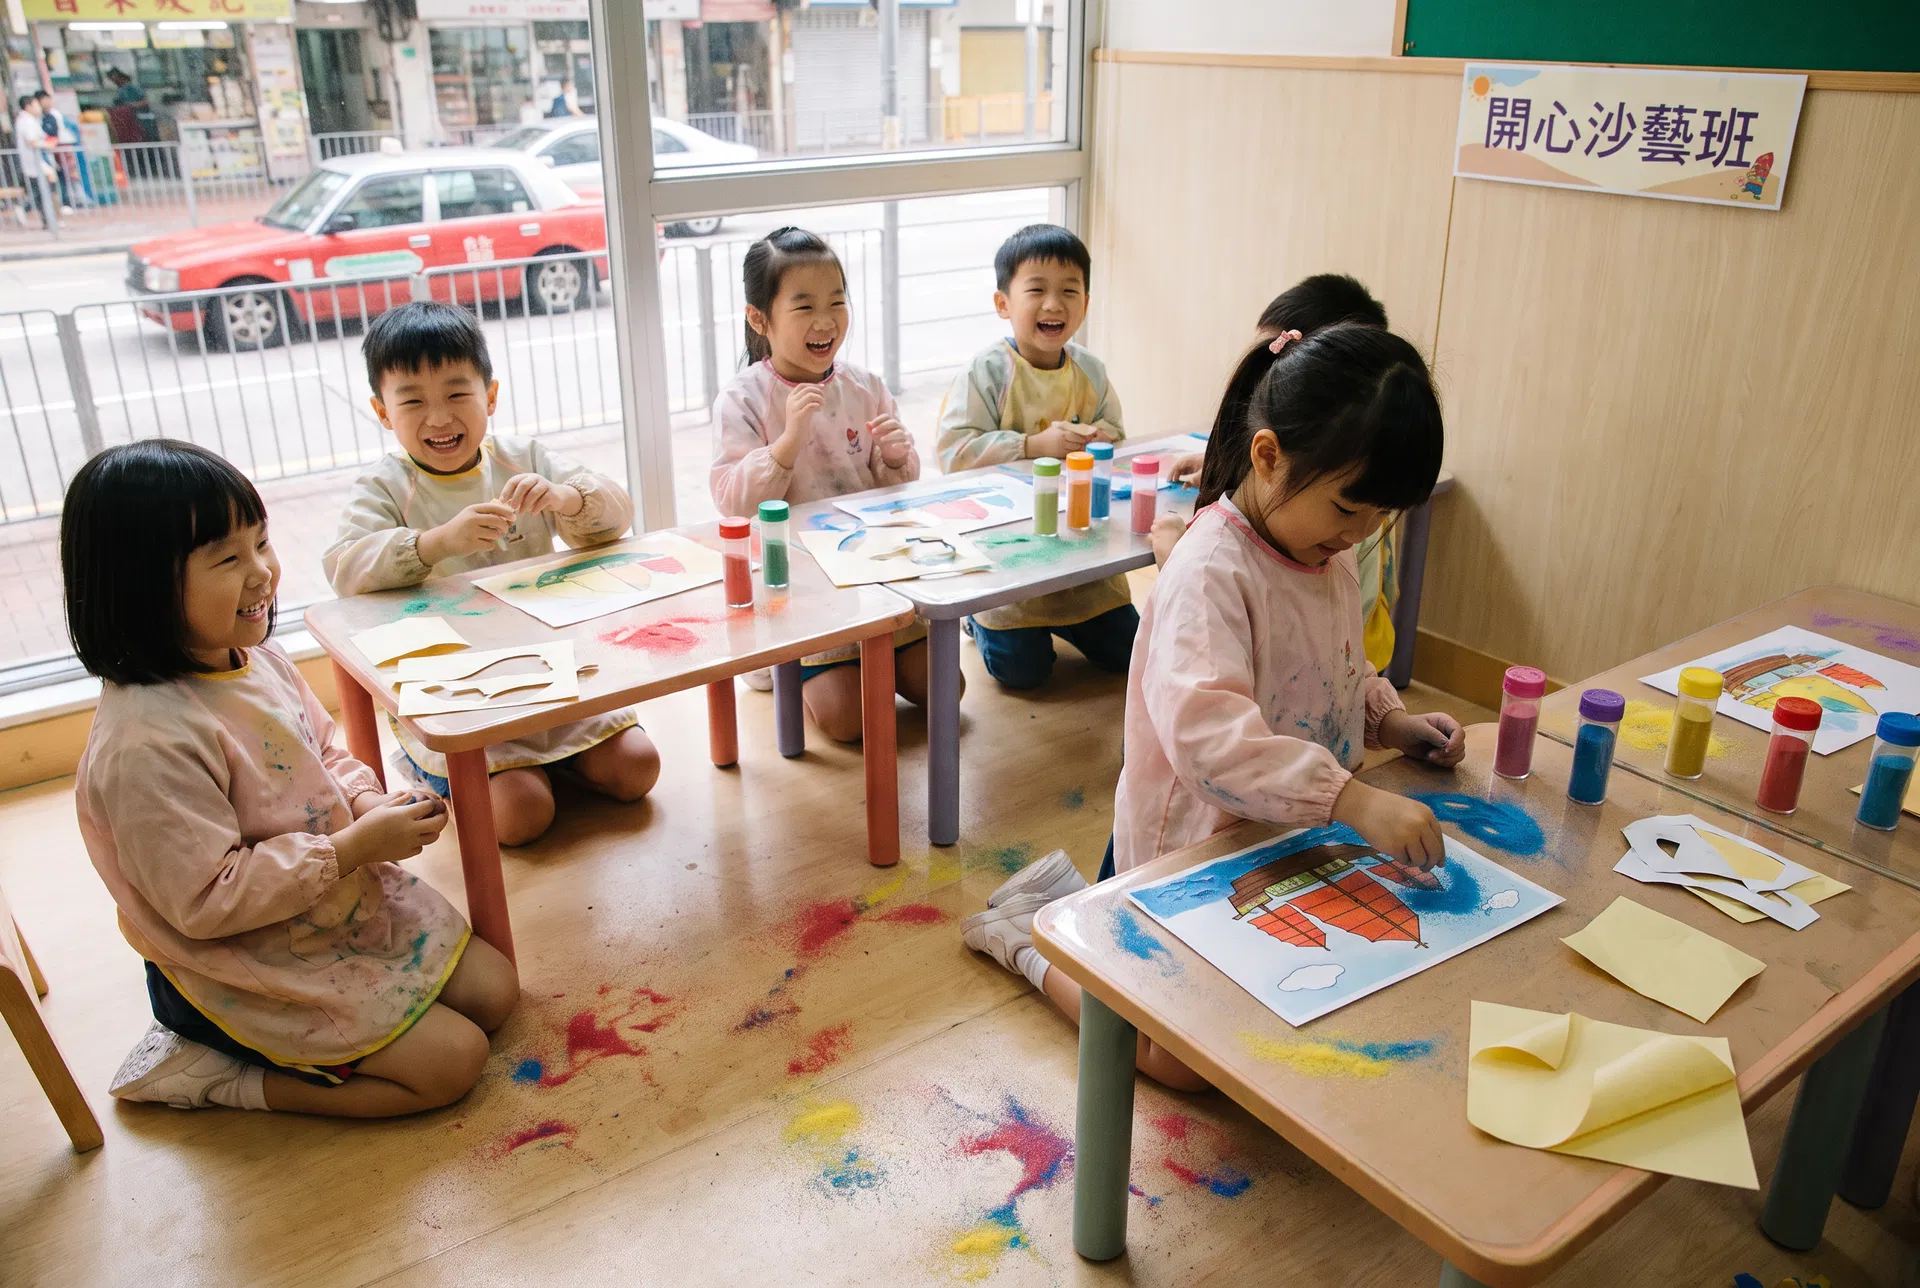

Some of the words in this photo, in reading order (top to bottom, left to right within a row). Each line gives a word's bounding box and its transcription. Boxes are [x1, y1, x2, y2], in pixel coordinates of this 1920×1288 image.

[1485, 96, 1760, 168] 開心沙藝班
